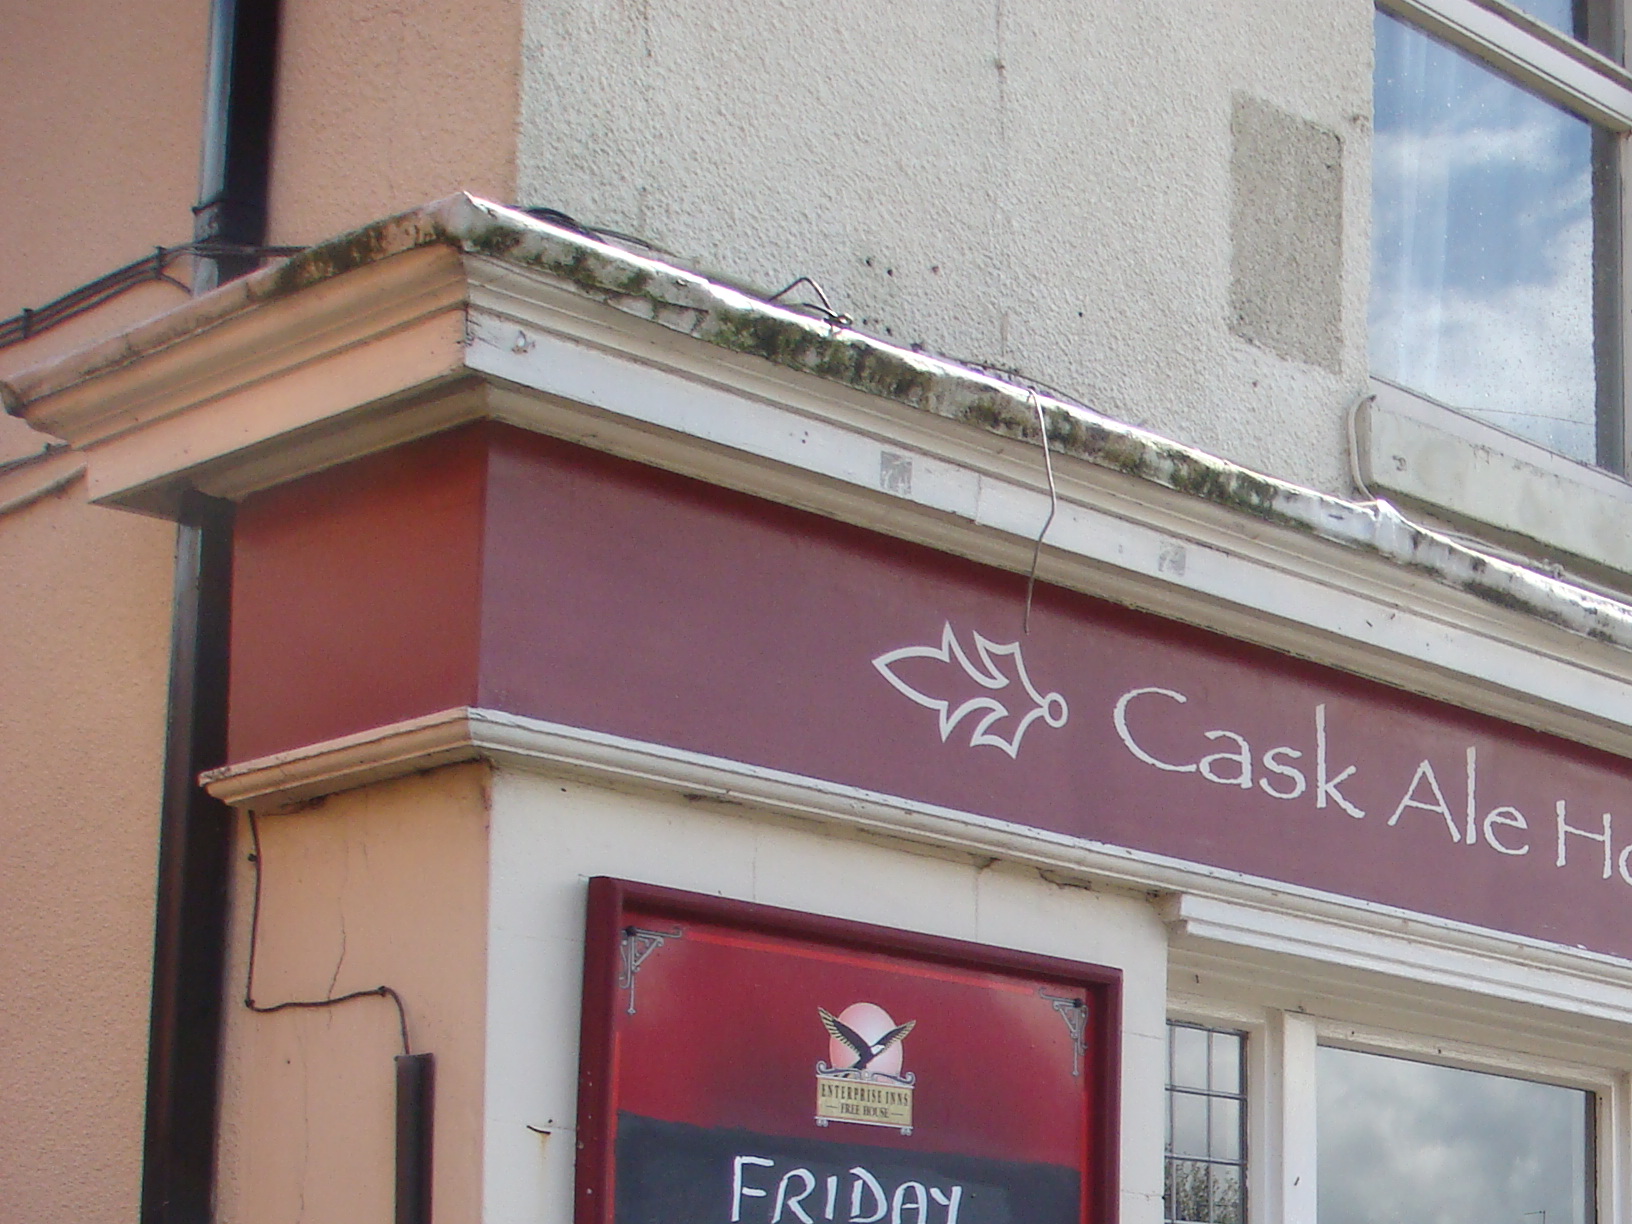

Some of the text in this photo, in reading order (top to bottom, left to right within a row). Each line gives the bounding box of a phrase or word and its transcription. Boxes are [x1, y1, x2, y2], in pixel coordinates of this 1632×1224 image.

[1113, 686, 1365, 819] Cask
[1386, 745, 1530, 856] Ale
[821, 1083, 909, 1106] ENTERPRISE INNS
